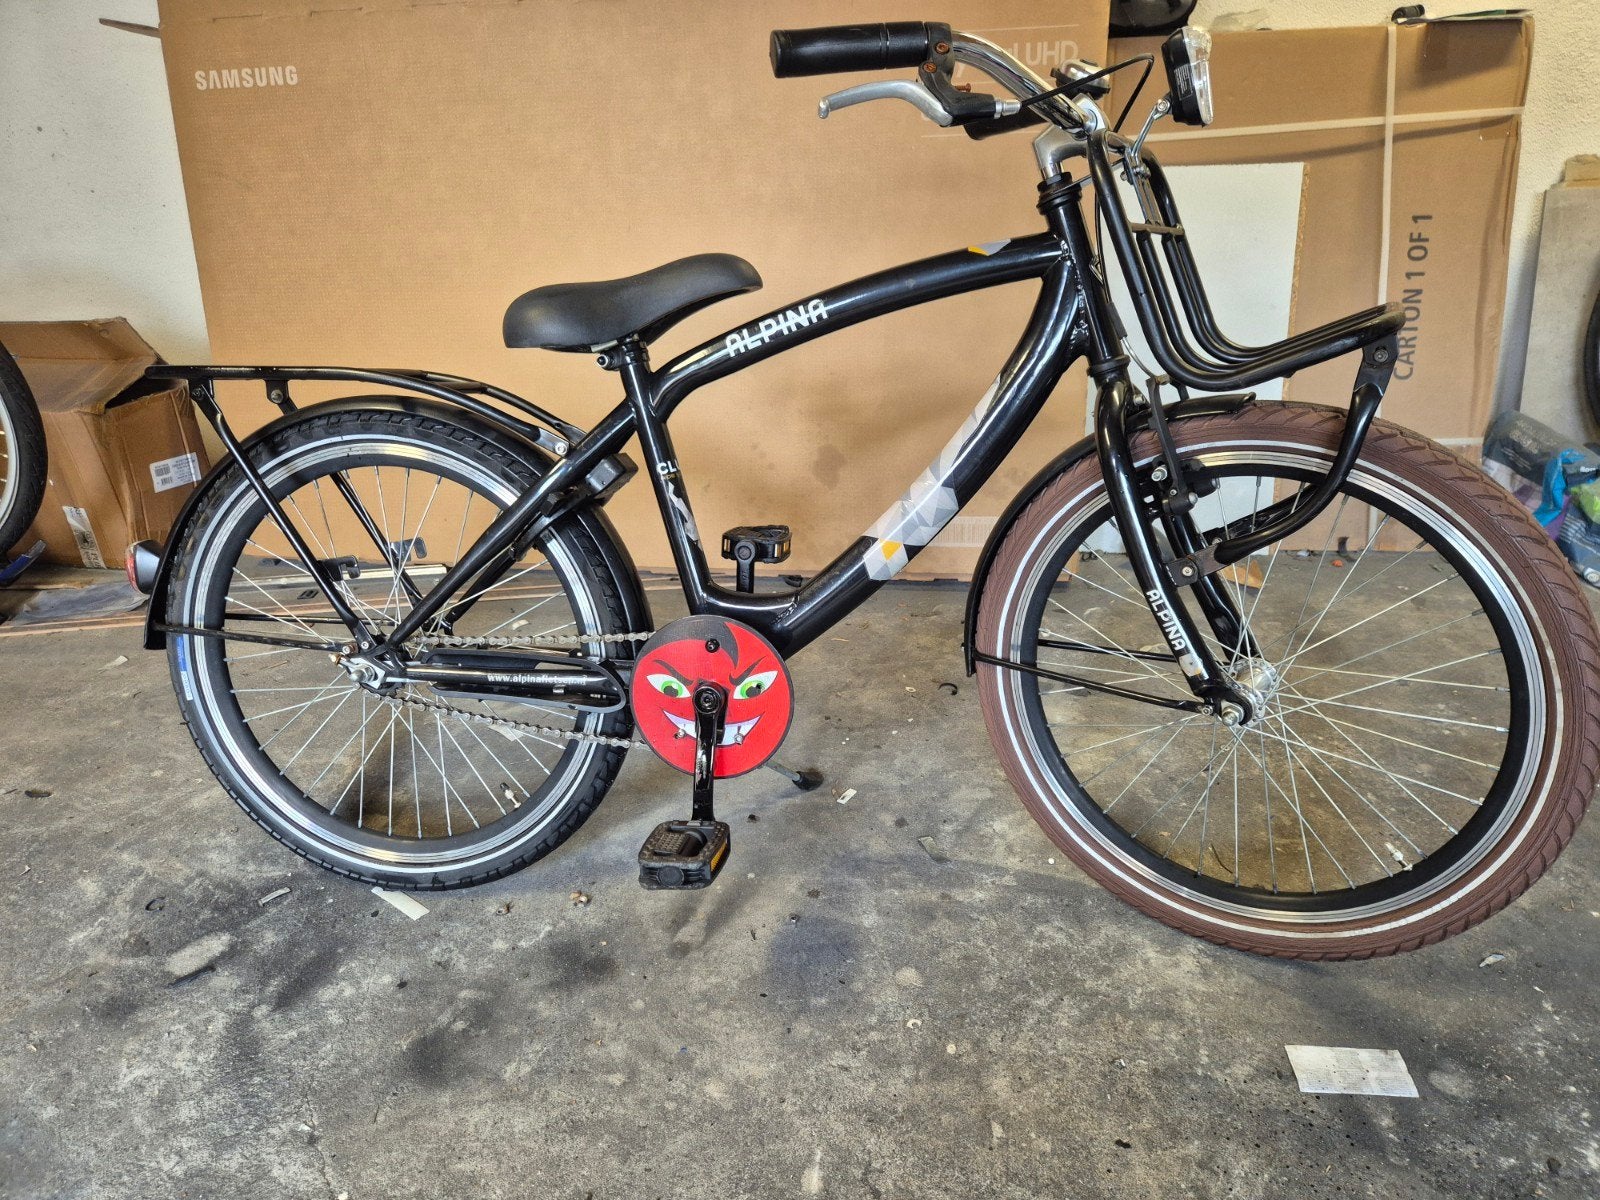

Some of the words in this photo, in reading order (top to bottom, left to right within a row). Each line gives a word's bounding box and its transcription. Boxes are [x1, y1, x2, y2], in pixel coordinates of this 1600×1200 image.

[1026, 41, 1079, 66] UHD
[194, 65, 299, 91] SAMSUNG
[1411, 215, 1433, 224] 1
[1407, 232, 1430, 261] OF
[1405, 271, 1426, 280] 1
[725, 299, 828, 357] ALPINA
[1394, 288, 1424, 380] CARTON
[1146, 589, 1186, 651] ALPINA
